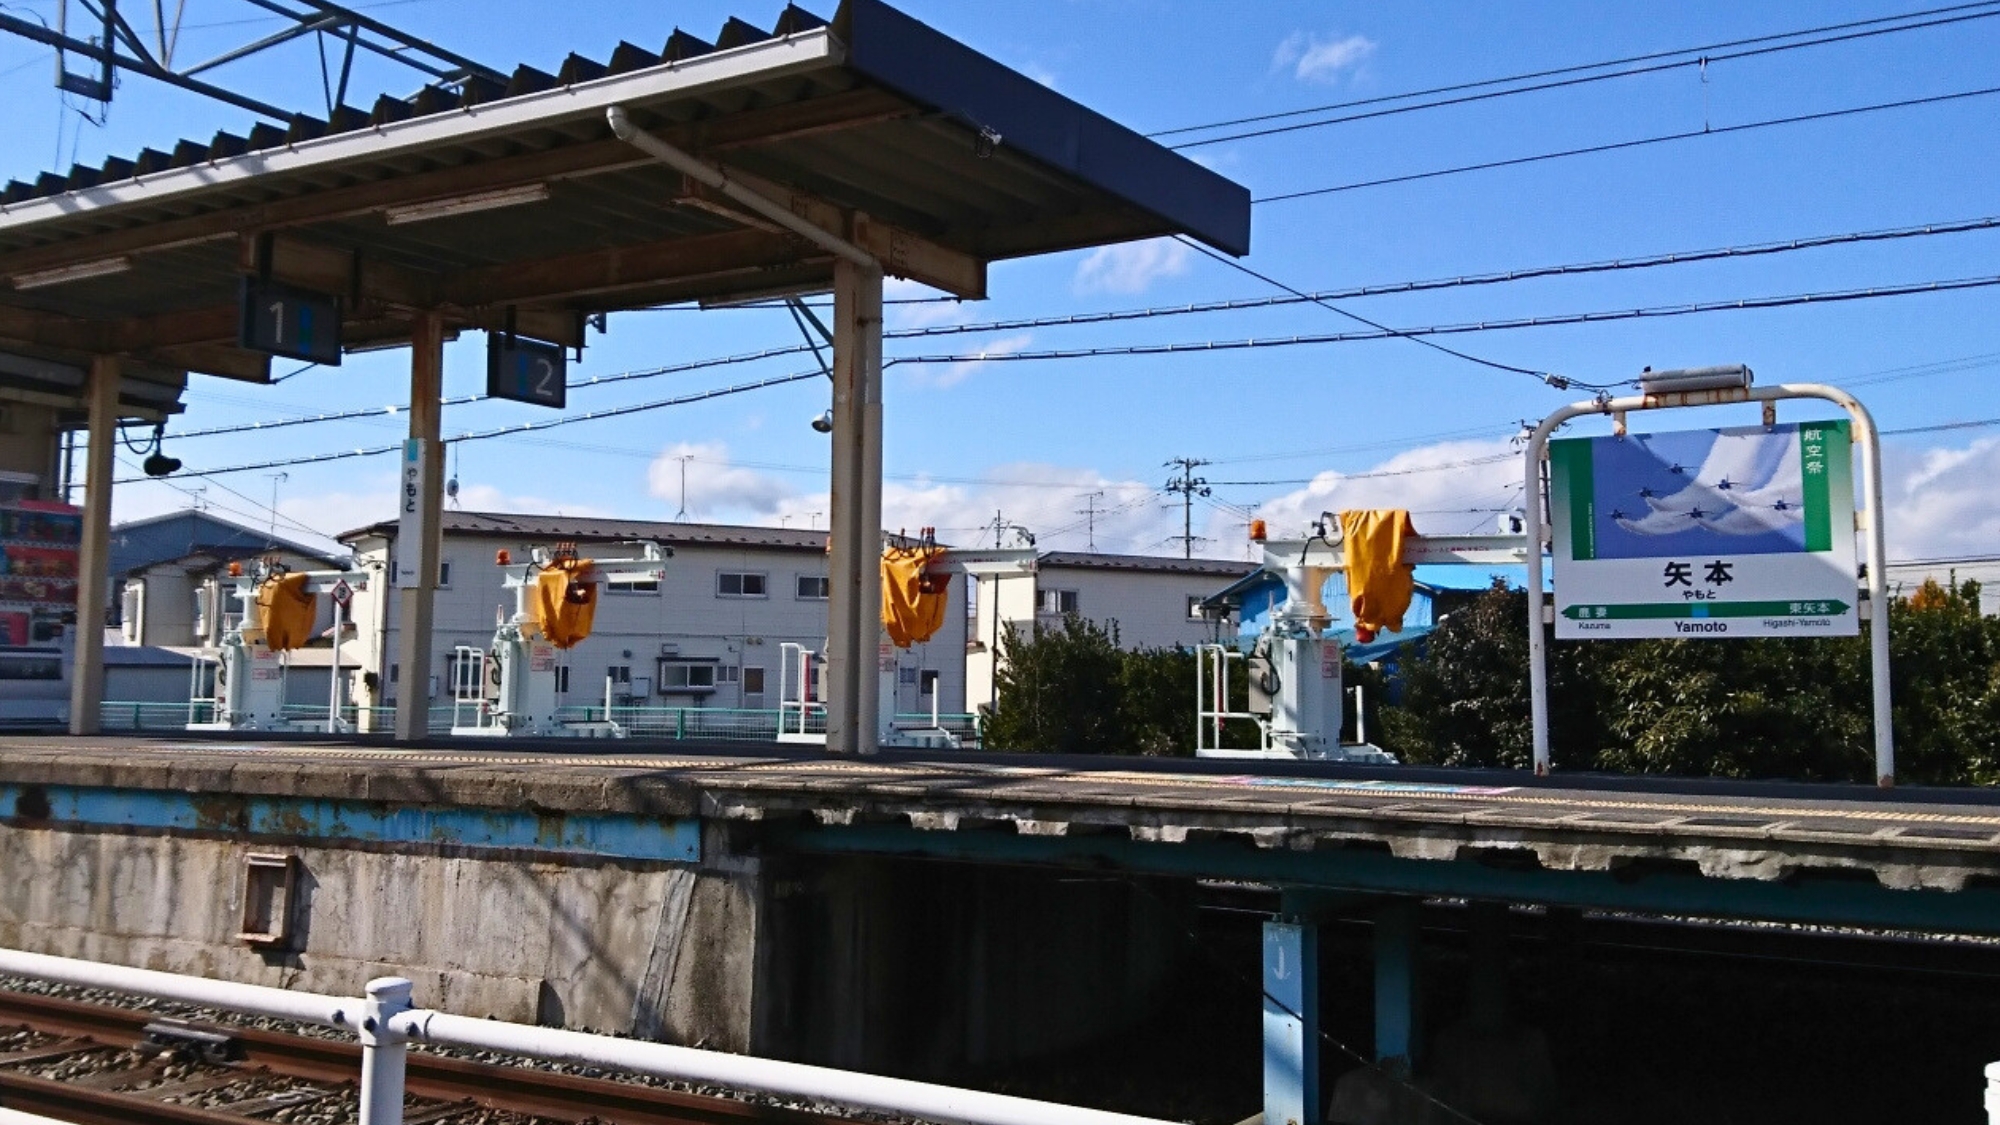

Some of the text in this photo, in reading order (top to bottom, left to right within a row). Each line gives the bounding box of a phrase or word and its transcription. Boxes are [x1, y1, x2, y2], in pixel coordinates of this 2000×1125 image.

[268, 301, 284, 345] 1
[535, 357, 553, 397] 2
[1803, 428, 1825, 475] 航空祭
[405, 467, 418, 514] やもと
[1663, 559, 1734, 588] 矢本
[1682, 588, 1717, 601] やもと
[1789, 602, 1831, 614] 東矢本
[1578, 621, 1612, 630] Kazuma
[1674, 621, 1728, 633] Yamoto
[1763, 618, 1831, 629] Higashi-Yamoto
